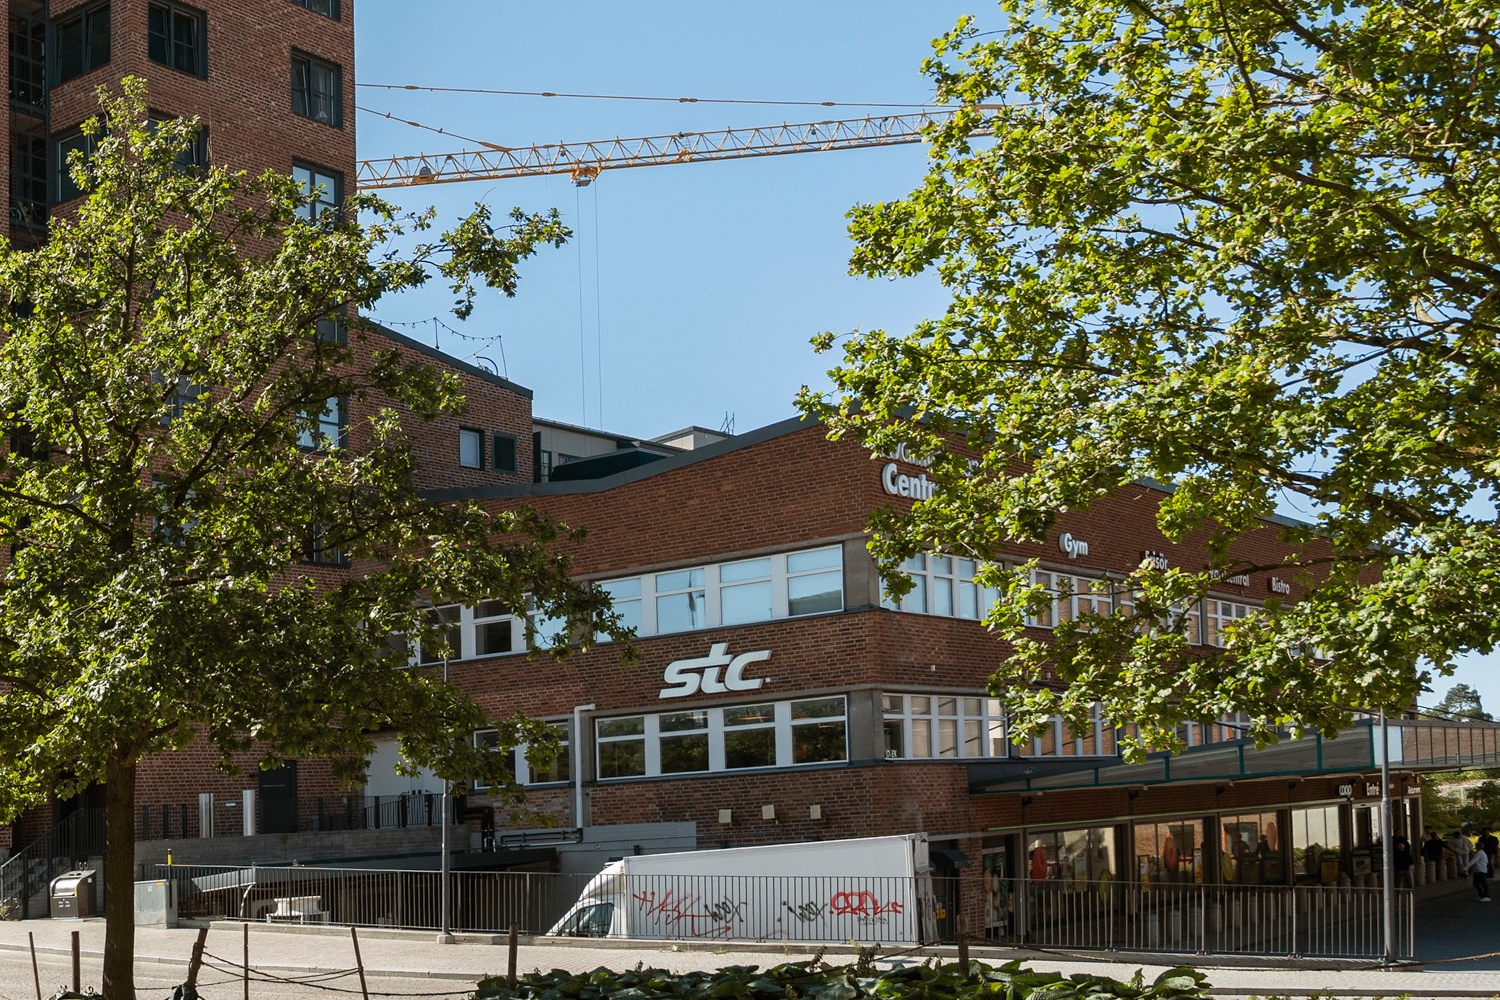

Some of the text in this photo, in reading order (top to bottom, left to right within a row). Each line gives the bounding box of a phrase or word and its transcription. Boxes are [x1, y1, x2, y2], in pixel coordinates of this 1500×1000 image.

[882, 463, 943, 500] Centr
[1060, 532, 1088, 559] Gym
[1271, 576, 1290, 595] Bistro
